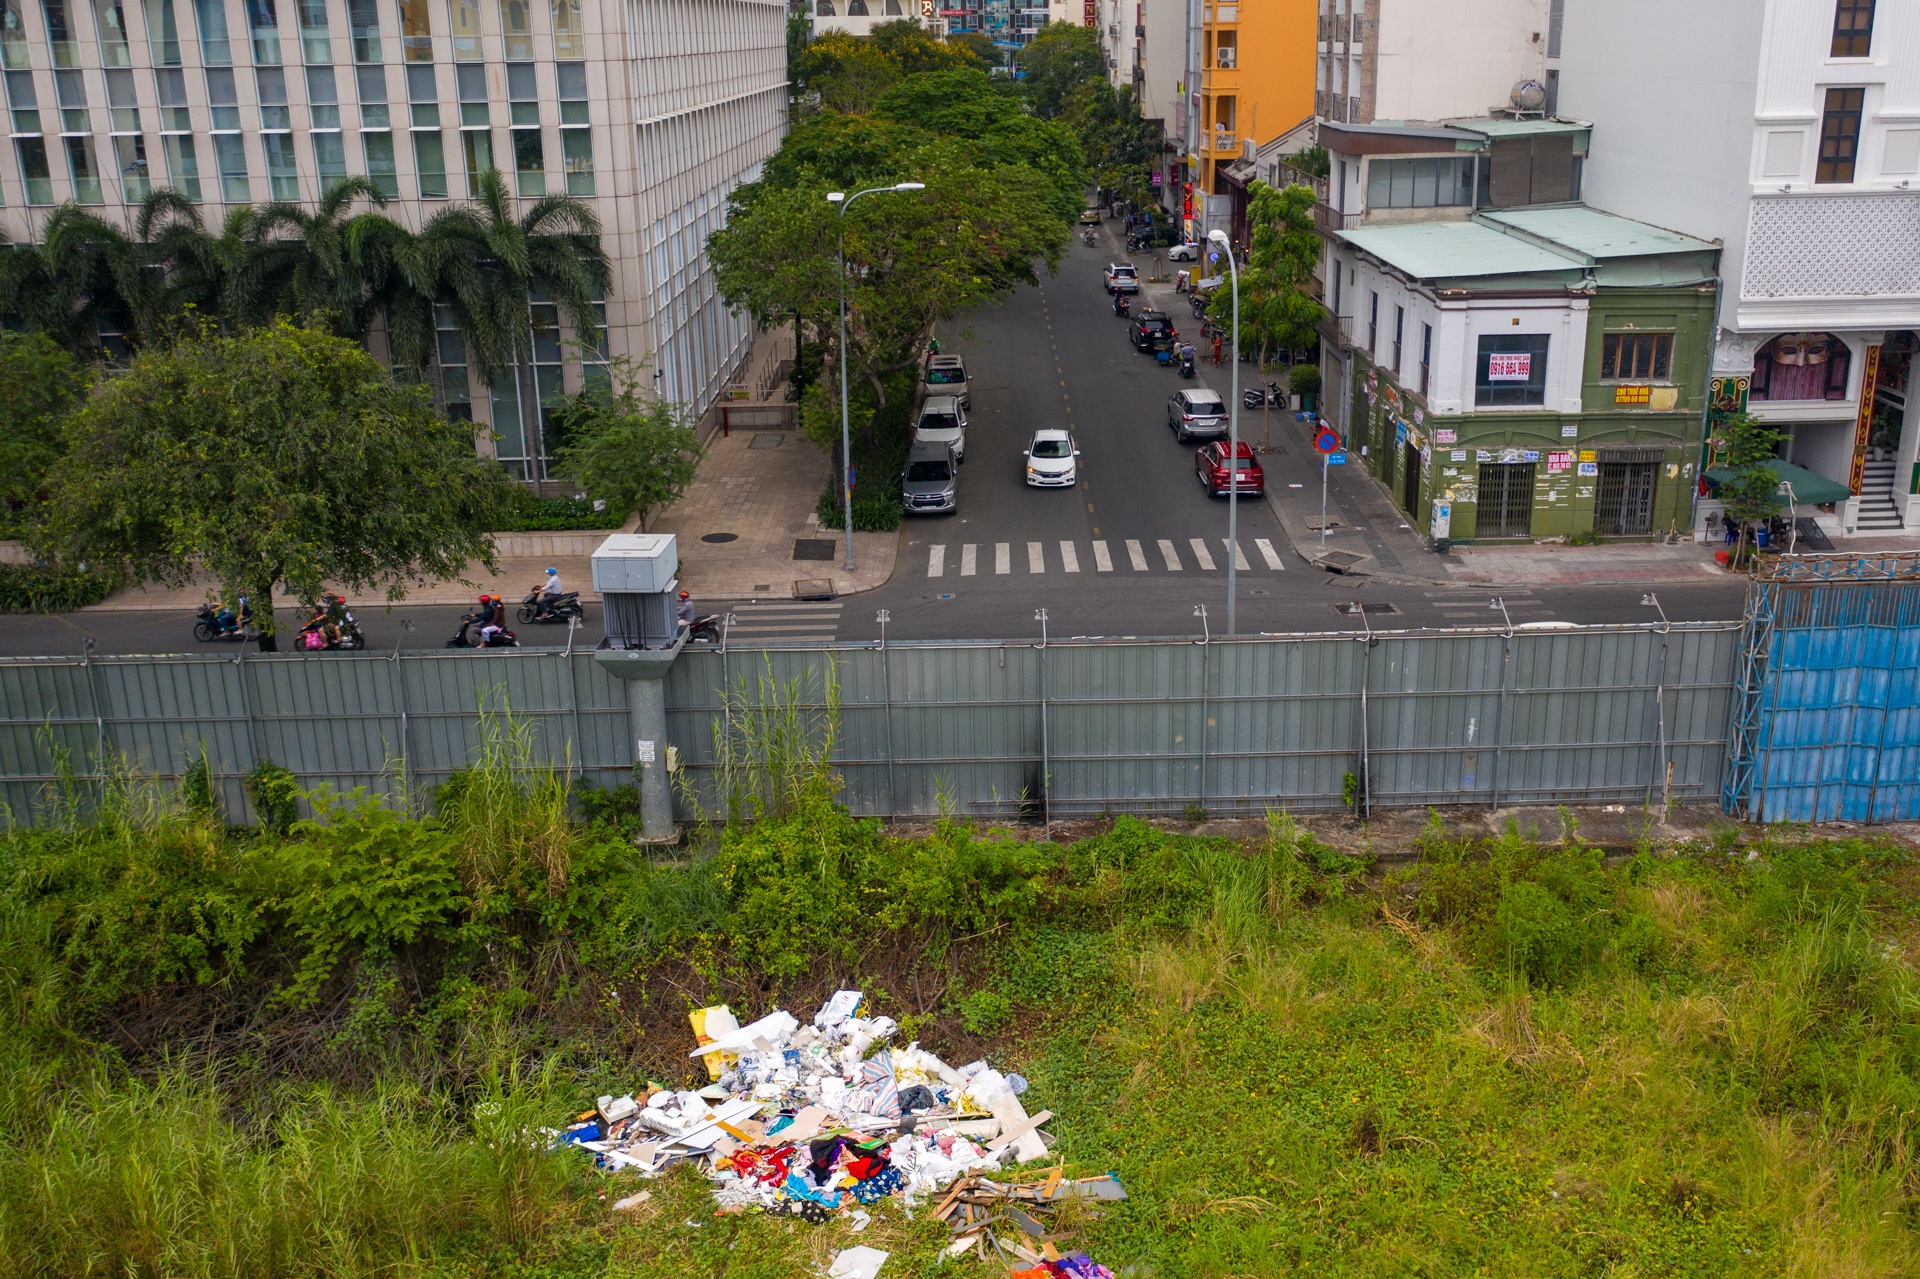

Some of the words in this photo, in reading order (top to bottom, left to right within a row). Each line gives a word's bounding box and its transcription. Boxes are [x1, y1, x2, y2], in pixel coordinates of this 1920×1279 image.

[1517, 362, 1529, 375] 999
[1616, 387, 1626, 396] CHO
[1627, 386, 1639, 396] THUÊ
